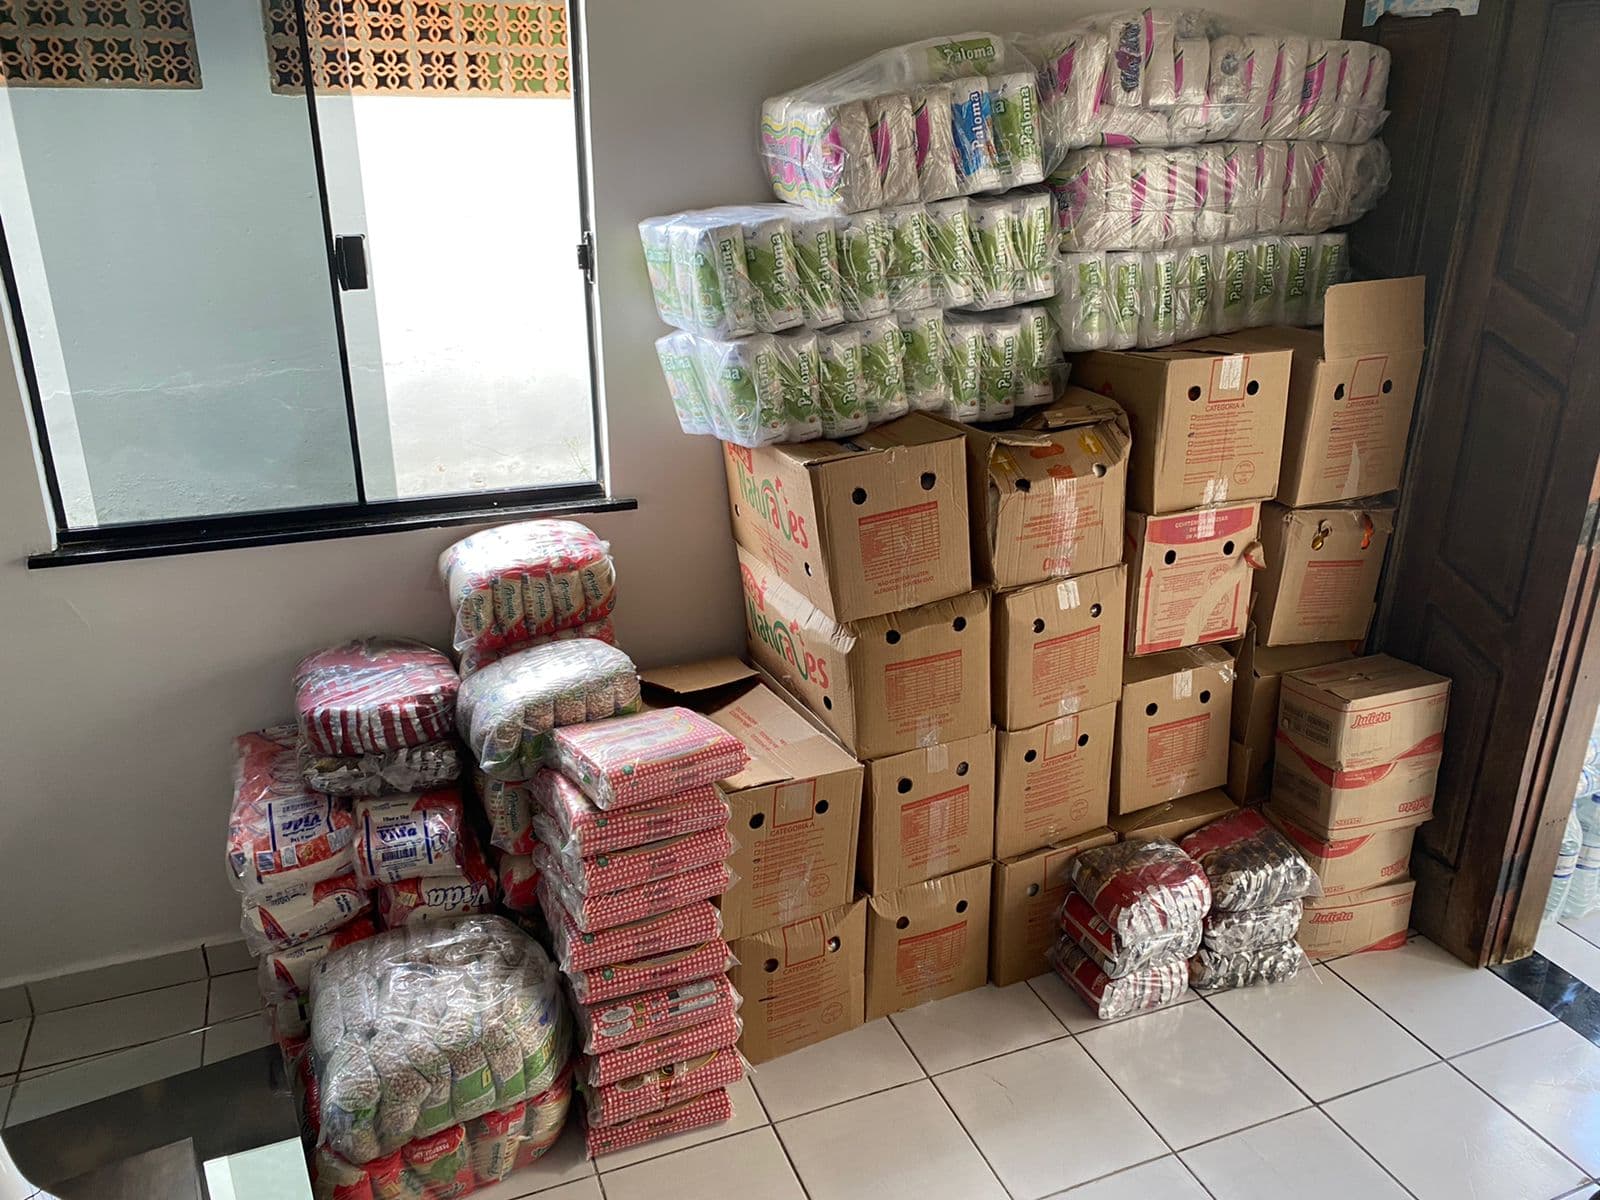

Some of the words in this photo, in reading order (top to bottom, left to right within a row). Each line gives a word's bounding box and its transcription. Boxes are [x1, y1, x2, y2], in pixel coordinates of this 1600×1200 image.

[943, 43, 996, 65] Paloma
[971, 90, 986, 151] Paloma
[1020, 86, 1033, 146] Paloma
[771, 231, 786, 293] Paloma
[816, 230, 829, 291] Paloma
[1230, 249, 1245, 302] Paloma
[1290, 246, 1308, 297] Paloma
[843, 346, 855, 404] Paloma
[962, 335, 976, 391] Paloma
[998, 335, 1013, 391] Paloma
[1205, 403, 1239, 412] CATEGORIA
[770, 823, 810, 837] CATEGORIA
[427, 884, 491, 913] Vida
